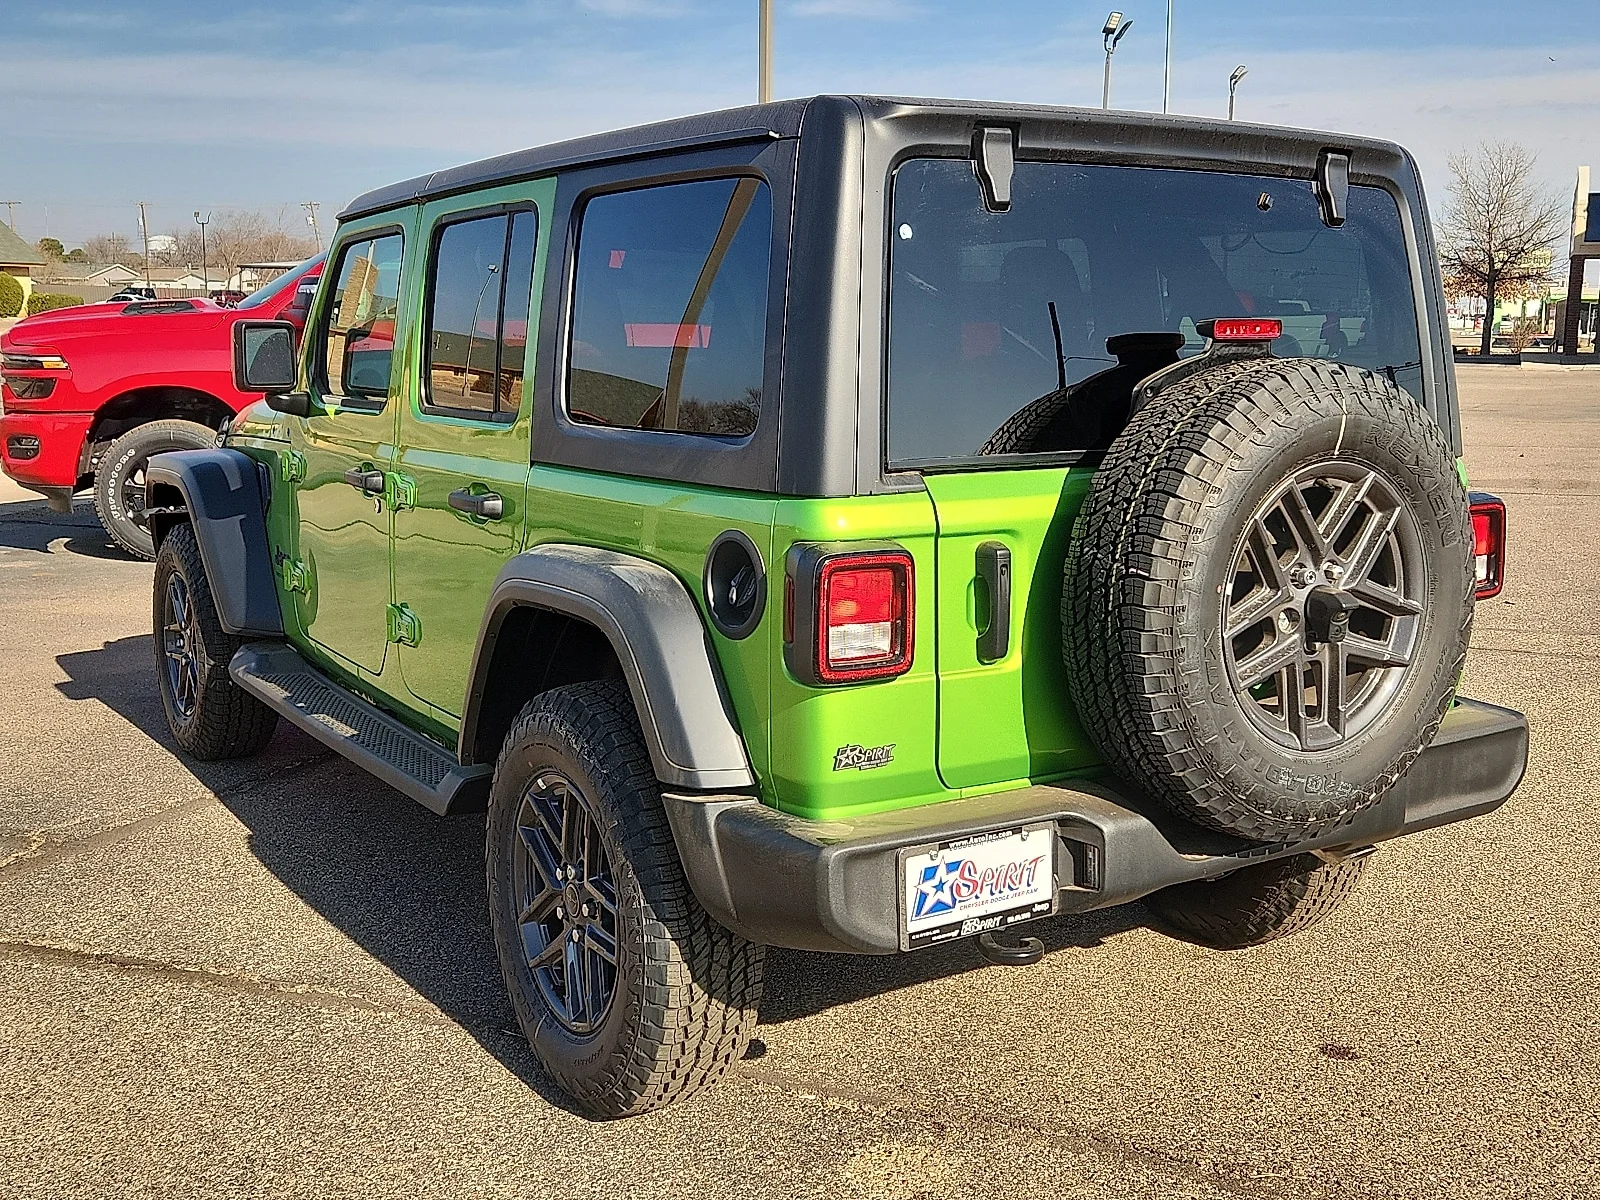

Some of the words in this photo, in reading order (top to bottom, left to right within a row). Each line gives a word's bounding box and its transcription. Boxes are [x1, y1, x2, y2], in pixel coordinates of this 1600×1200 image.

[1363, 423, 1460, 548] NEXEN
[853, 743, 897, 765] SPIRIT
[953, 854, 1047, 901] SPIRIT
[959, 899, 989, 911] CHRYSLER
[990, 894, 1010, 904] DODGE
[972, 915, 1004, 934] SPIRIT
